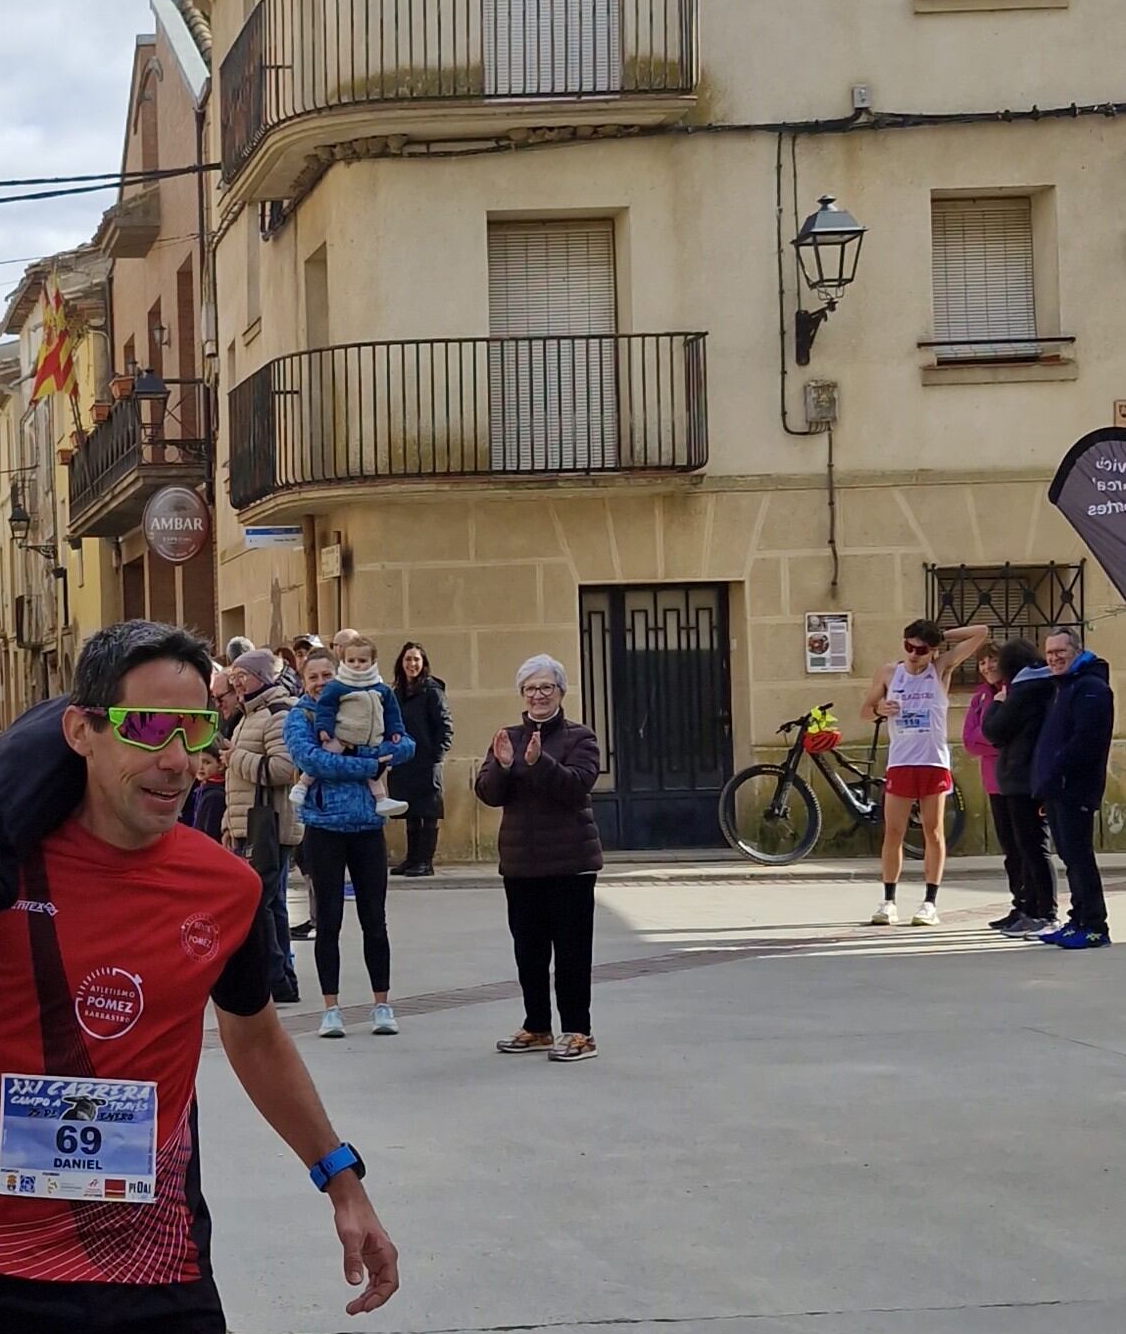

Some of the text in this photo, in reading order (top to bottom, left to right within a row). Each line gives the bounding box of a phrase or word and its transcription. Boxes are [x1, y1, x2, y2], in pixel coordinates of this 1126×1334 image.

[150, 517, 204, 532] AMBAR
[89, 985, 135, 998] ATLETISMO
[87, 995, 134, 1014] PÓMEZ
[84, 1009, 131, 1023] BARBASTRO
[8, 1078, 151, 1101] XXI CARRERA
[10, 1095, 51, 1107] CAMPO
[51, 1098, 62, 1108] A
[56, 1125, 102, 1155] 69
[53, 1157, 103, 1170] DANIEL
